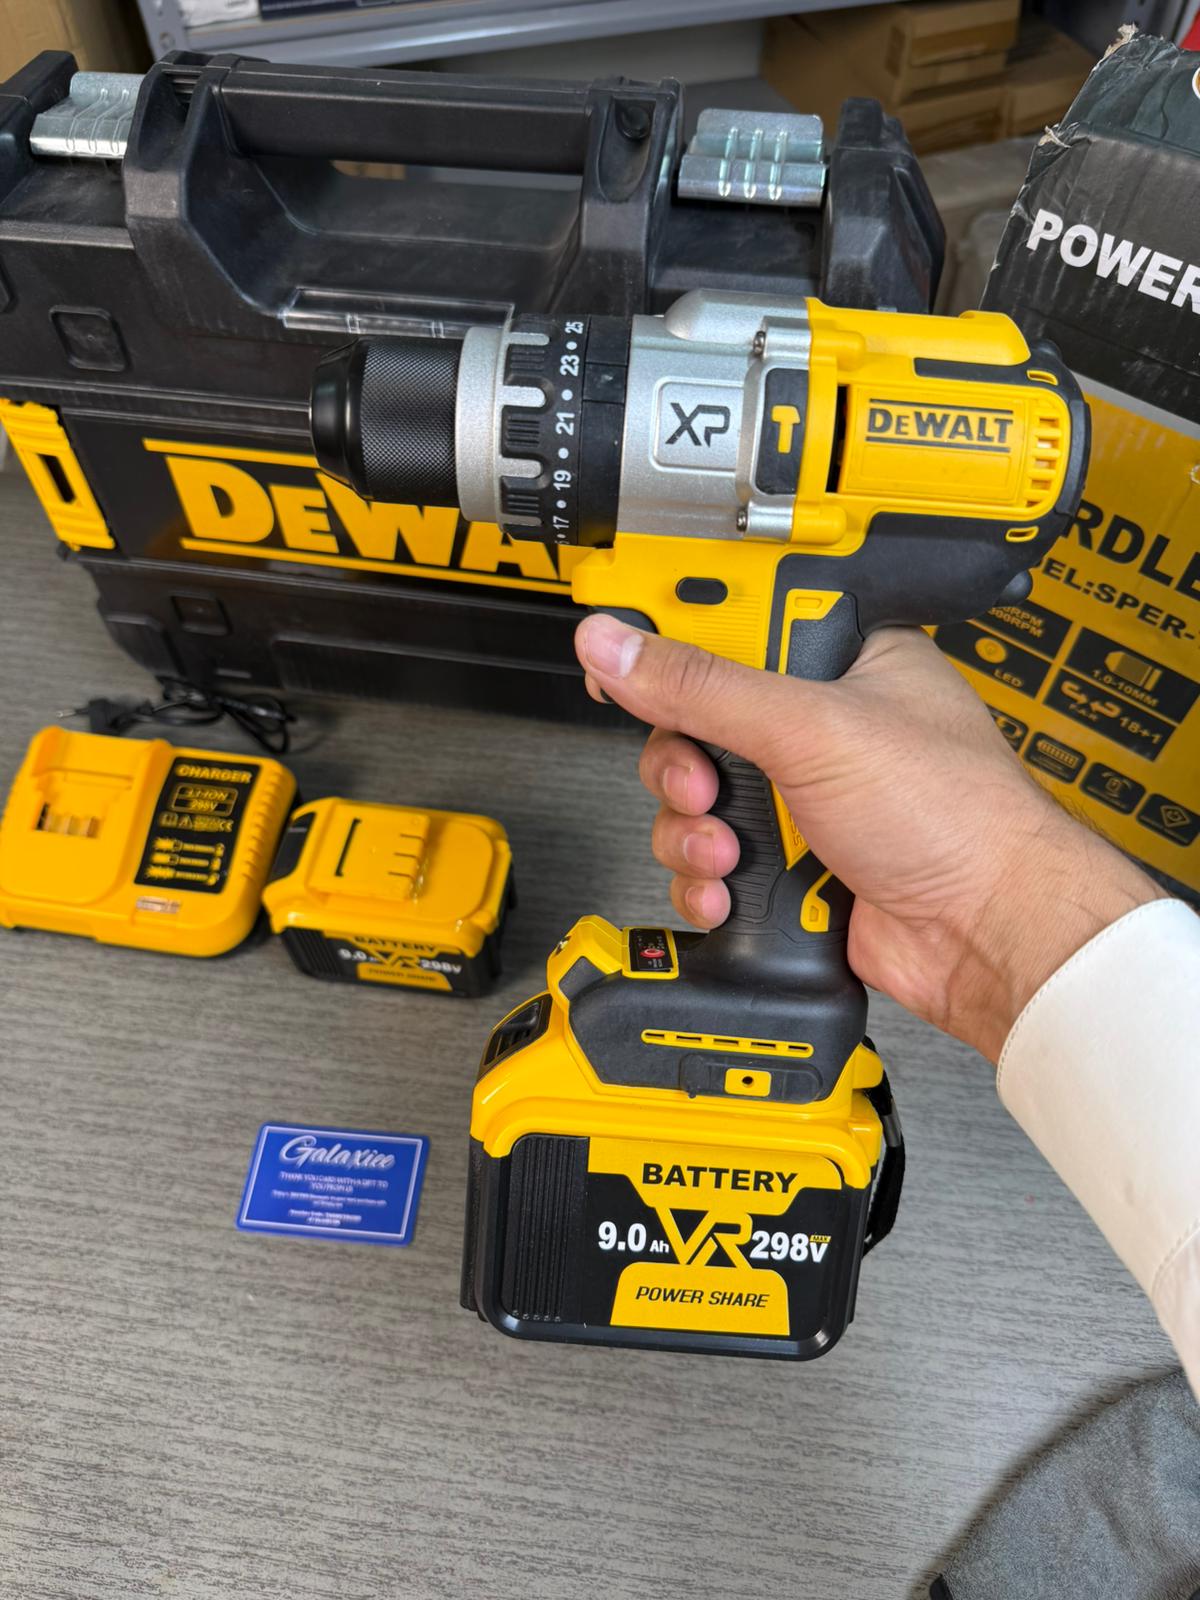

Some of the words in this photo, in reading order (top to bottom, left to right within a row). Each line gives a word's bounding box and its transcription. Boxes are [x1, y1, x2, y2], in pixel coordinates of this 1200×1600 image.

[565, 321, 584, 334] 25
[560, 354, 580, 377] 23
[556, 412, 575, 436] 21
[665, 402, 731, 447] XP
[554, 470, 571, 490] 19
[165, 455, 590, 583] DEWA
[993, 667, 1024, 689] LED
[177, 764, 252, 784] CHARGER
[642, 1163, 798, 1193] BATTERY
[598, 1221, 647, 1252] 9.0
[649, 1240, 670, 1253] Ah
[635, 1286, 705, 1304] POWER
[708, 1290, 770, 1308] SHARE
